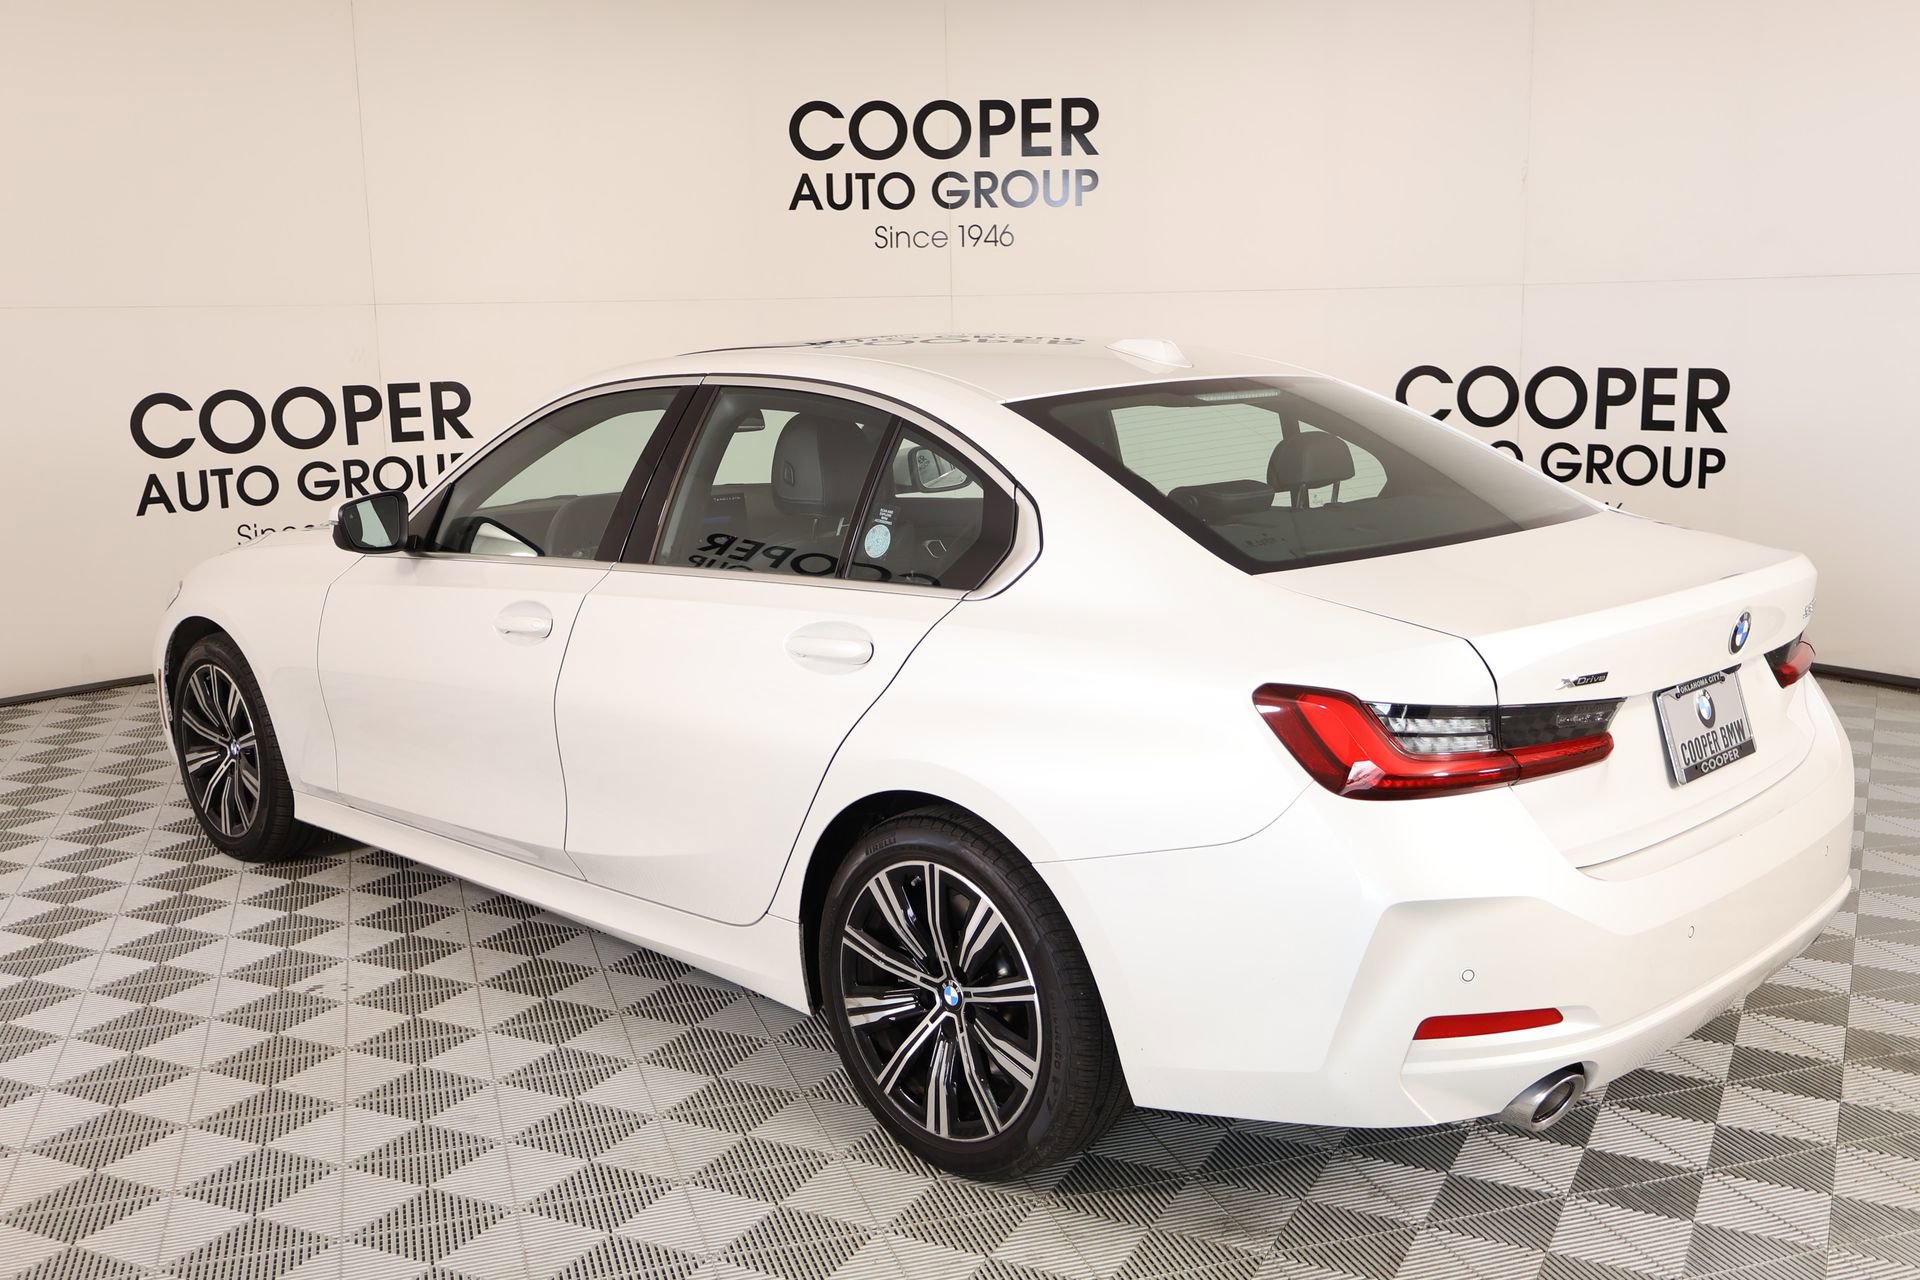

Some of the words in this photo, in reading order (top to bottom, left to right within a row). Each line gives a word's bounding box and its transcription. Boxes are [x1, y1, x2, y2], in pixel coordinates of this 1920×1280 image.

[789, 97, 1100, 161] COOPER
[788, 171, 916, 211] AUTO
[931, 169, 1099, 210] GROUP
[874, 225, 949, 249] Since
[958, 224, 1015, 248] 1946
[130, 380, 475, 459] COOPER
[1395, 365, 1730, 434] COOPER
[136, 464, 280, 517] AUTO
[297, 452, 465, 502] GROU
[1540, 442, 1726, 490] GROUP
[1680, 677, 1707, 694] OKLAHOMA
[1707, 673, 1721, 684] CITY
[1680, 730, 1721, 767] COOPER
[1719, 718, 1747, 749] BMW
[1700, 748, 1740, 773] COOPER
